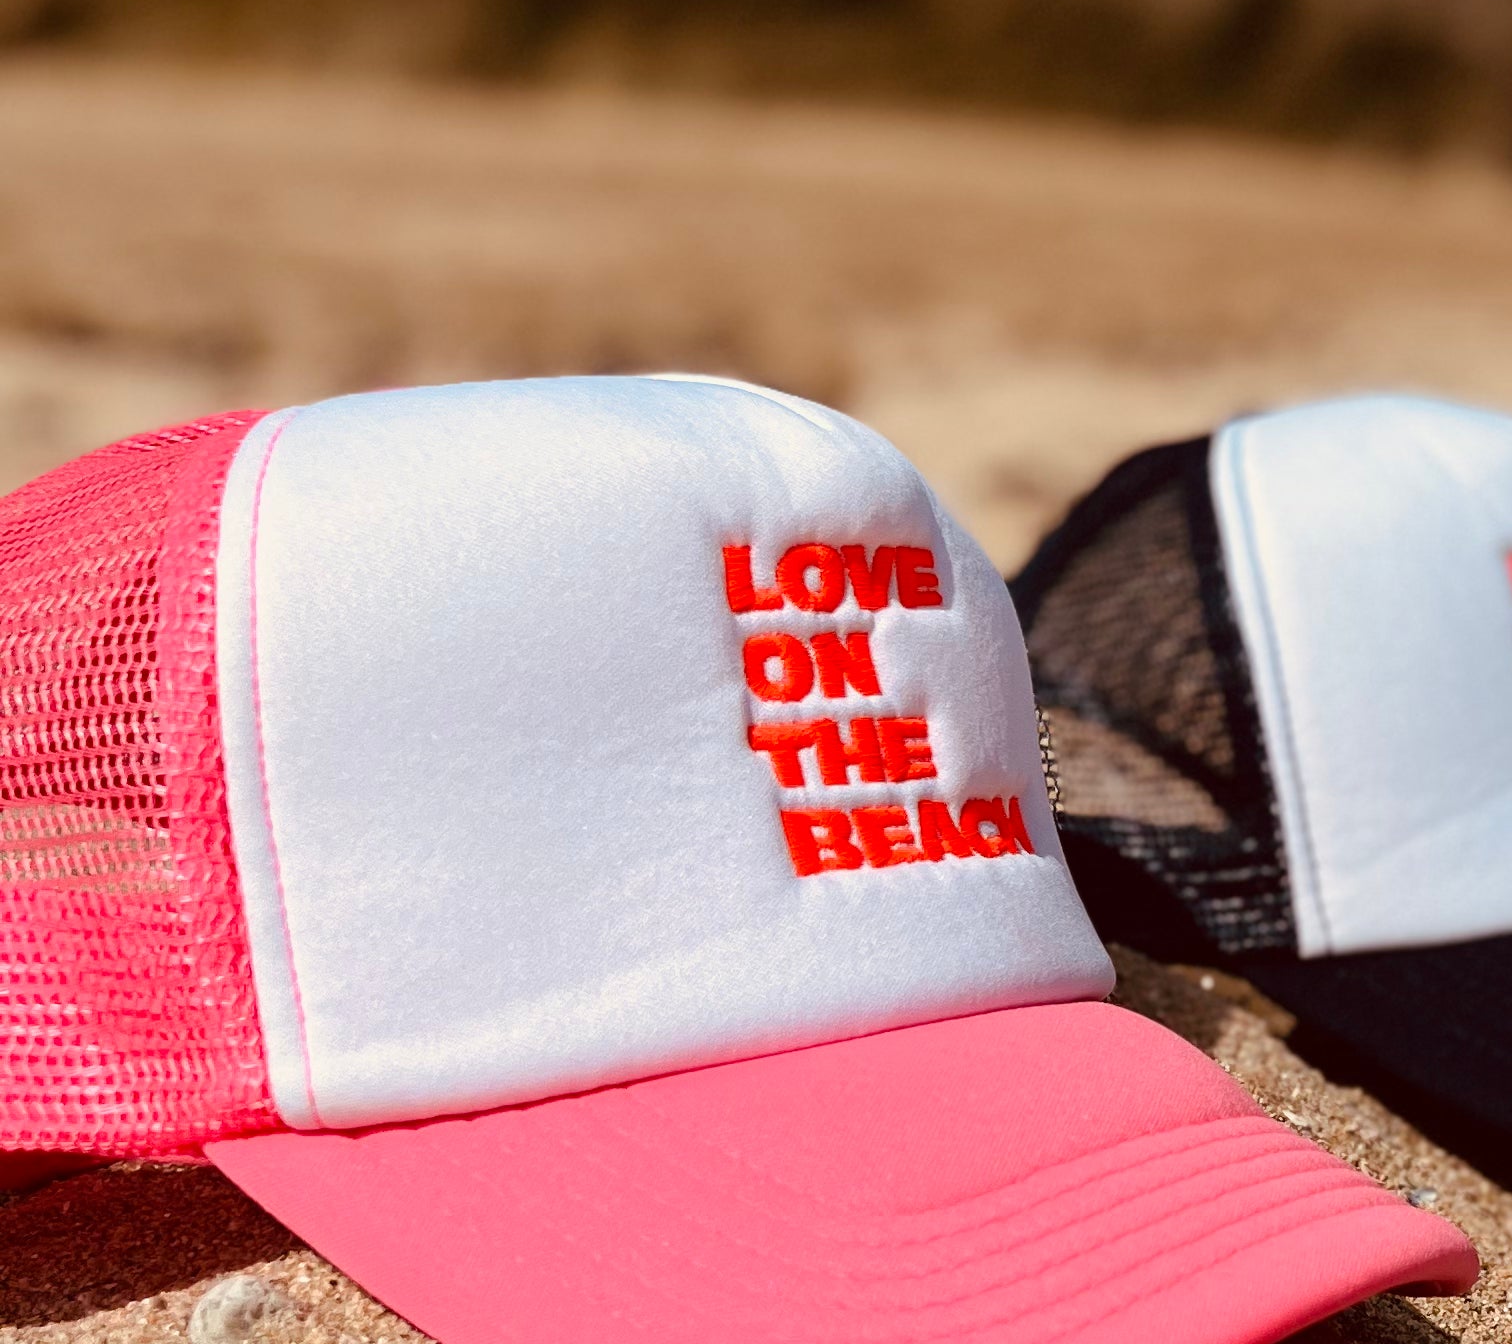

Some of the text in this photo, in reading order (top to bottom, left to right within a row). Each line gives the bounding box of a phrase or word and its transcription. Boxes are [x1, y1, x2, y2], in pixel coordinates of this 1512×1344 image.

[722, 544, 943, 613] LOVE
[743, 632, 882, 704] ON
[748, 717, 938, 788] THE
